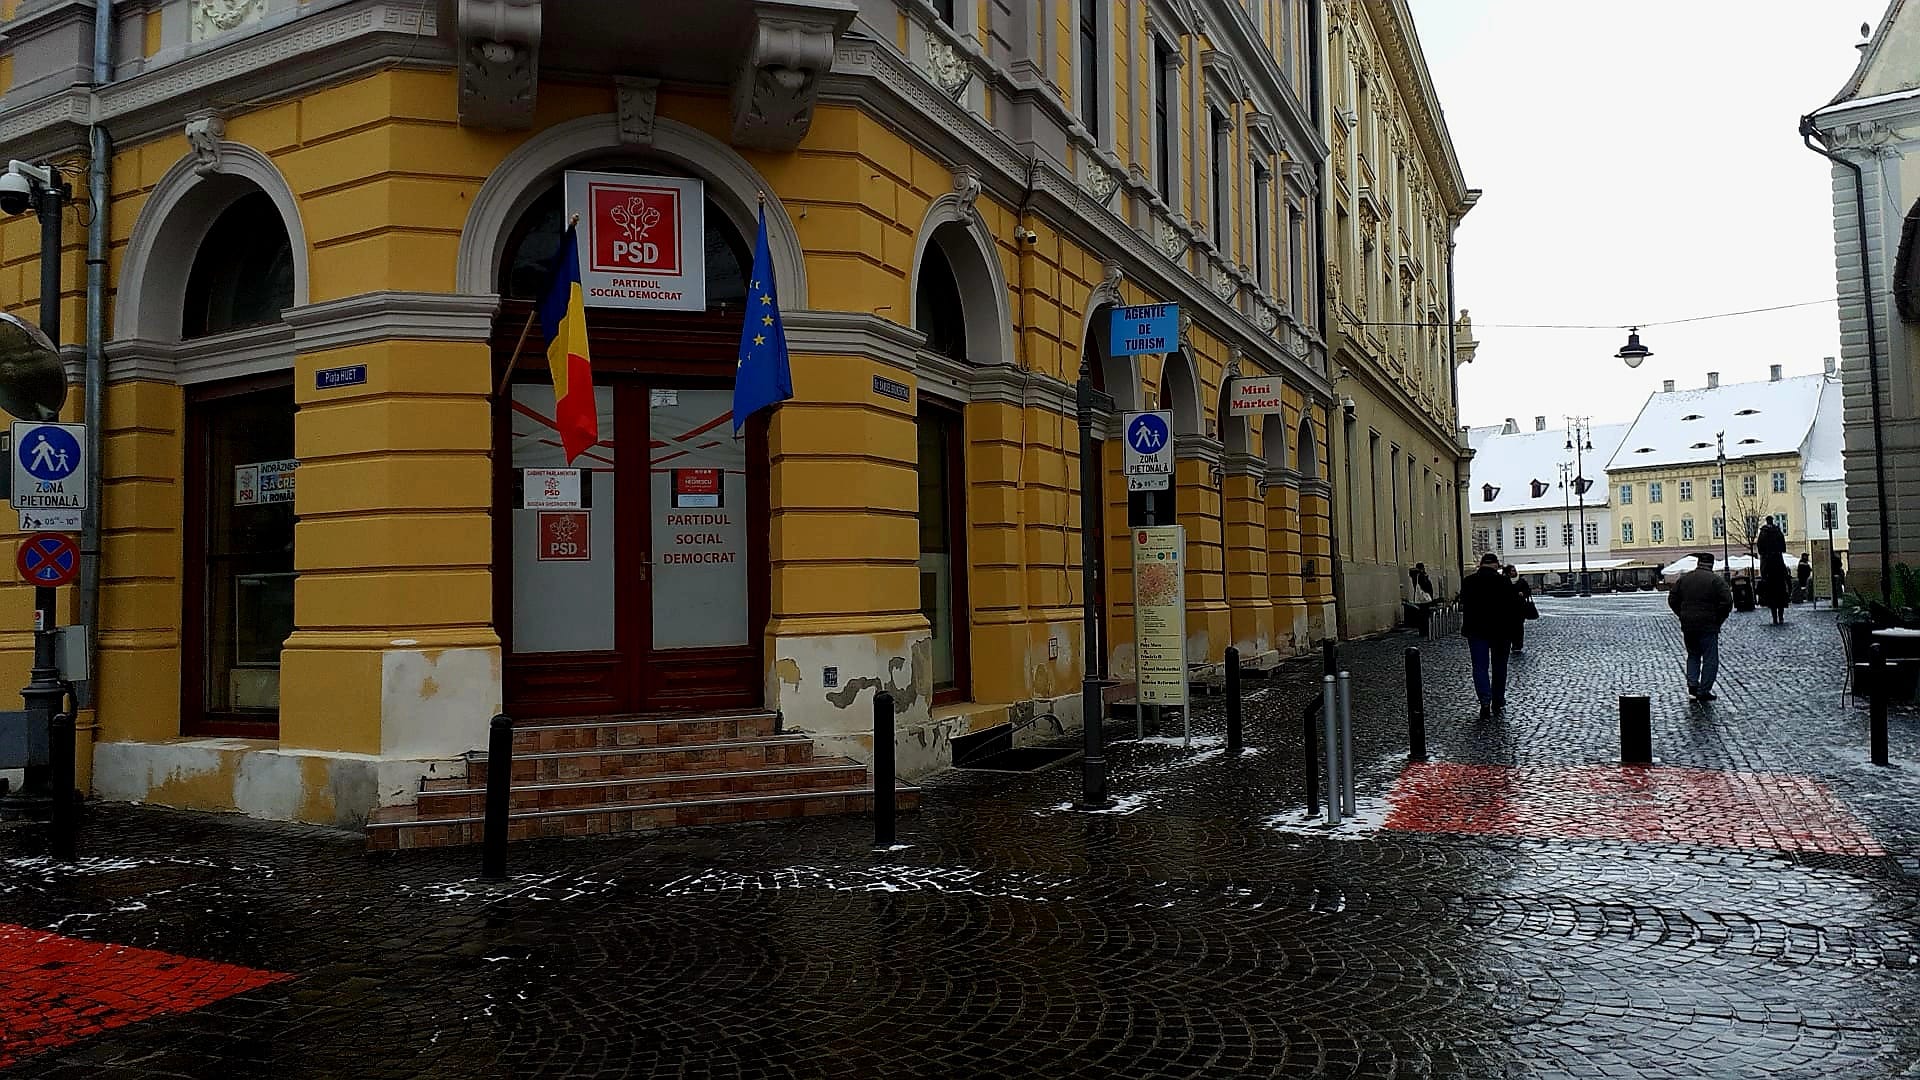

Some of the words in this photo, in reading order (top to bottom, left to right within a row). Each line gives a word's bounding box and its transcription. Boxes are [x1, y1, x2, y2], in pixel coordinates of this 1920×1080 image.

[613, 240, 659, 264] PSD
[612, 279, 661, 289] PARTIDUL
[590, 287, 626, 298] SOCIAL
[628, 290, 683, 300] DEMOCRAT
[1138, 323, 1152, 335] DE
[1125, 337, 1165, 351] TURISM
[340, 368, 357, 381] HUET
[1241, 384, 1270, 395] Mini
[1232, 398, 1279, 409] Market
[1129, 463, 1169, 473] PIETONALĂ
[20, 494, 79, 507] PIETONALĂ
[239, 489, 254, 501] PSD
[667, 514, 731, 526] PARTIDUL
[676, 533, 724, 545] SOCIAL
[550, 542, 578, 555] PSD
[663, 552, 736, 565] DEMOCRAT
